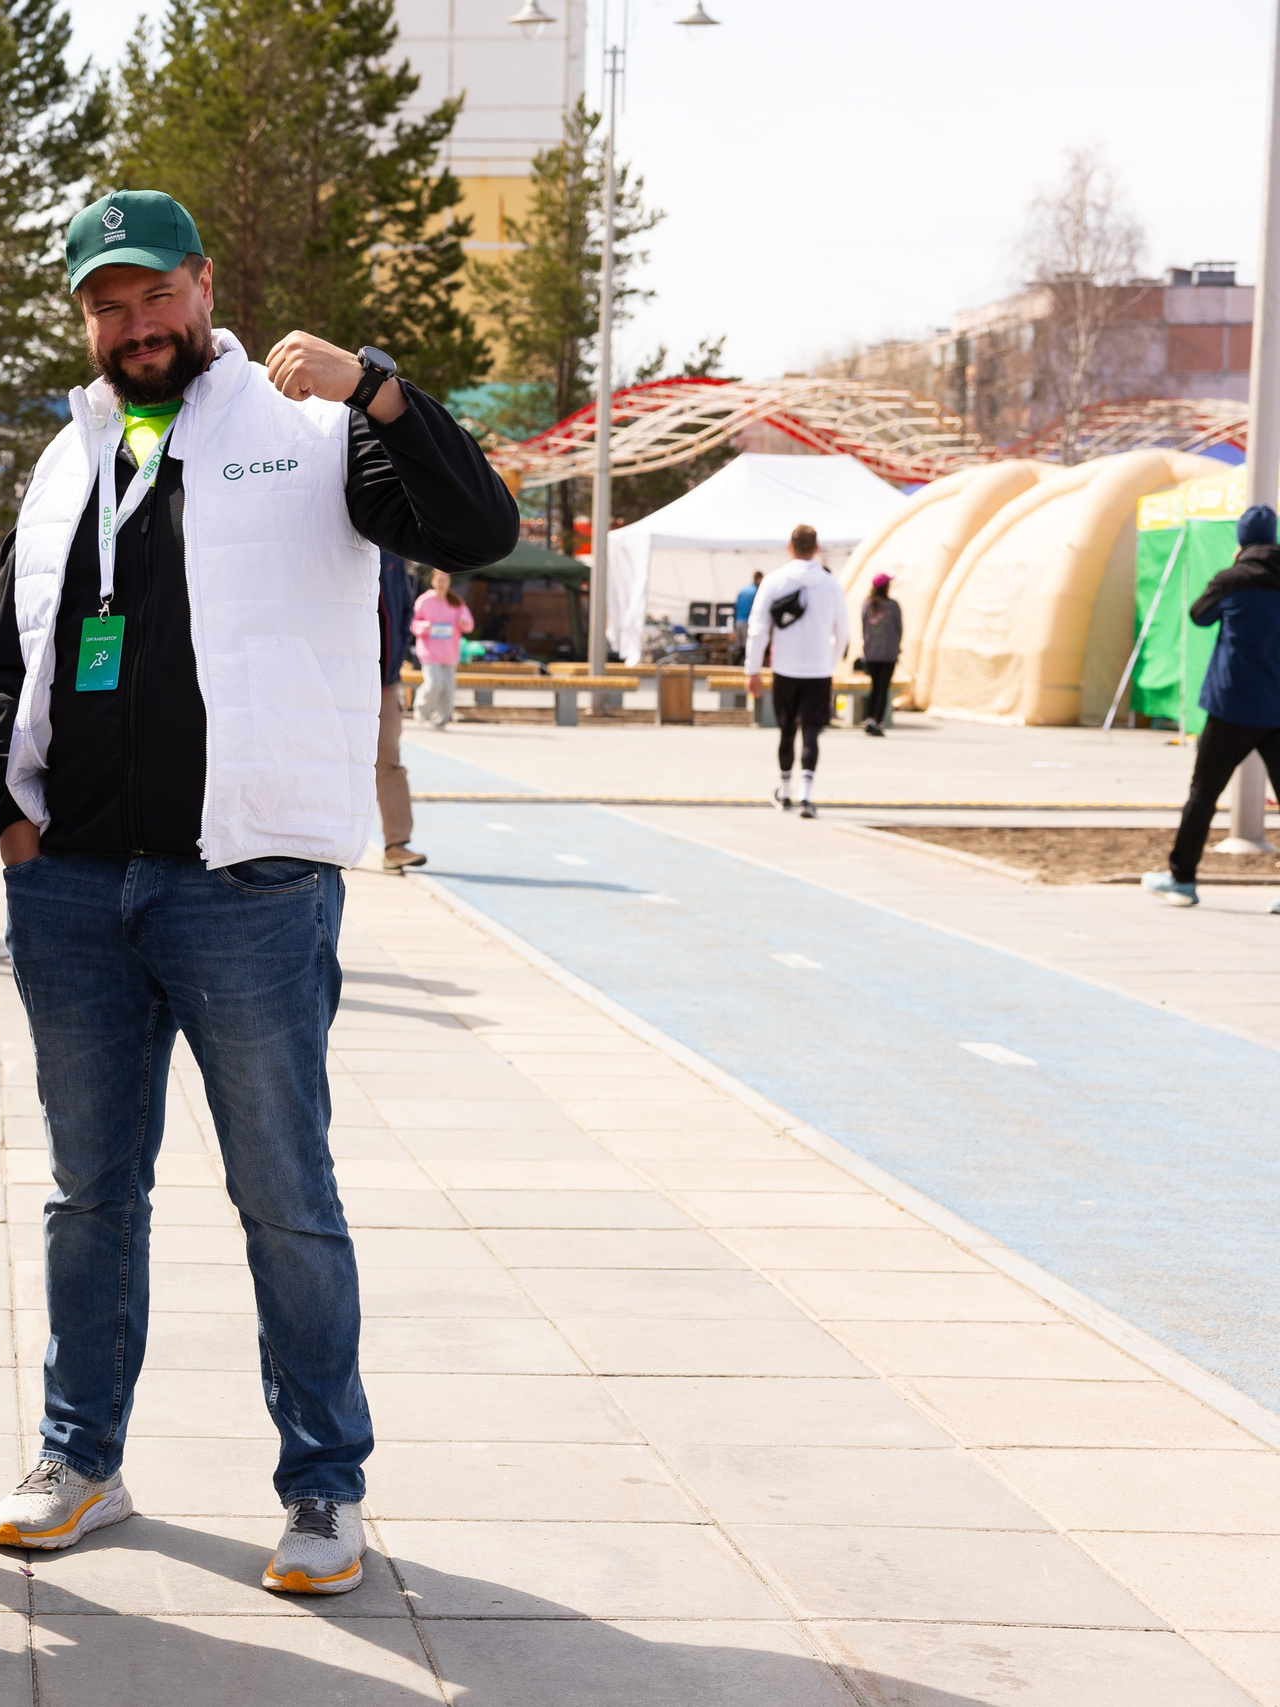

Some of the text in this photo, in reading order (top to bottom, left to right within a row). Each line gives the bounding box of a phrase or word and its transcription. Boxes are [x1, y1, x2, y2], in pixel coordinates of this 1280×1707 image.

[142, 454, 162, 480] СБЕР
[249, 459, 299, 474] СБЕР
[103, 506, 112, 535] СБЕР
